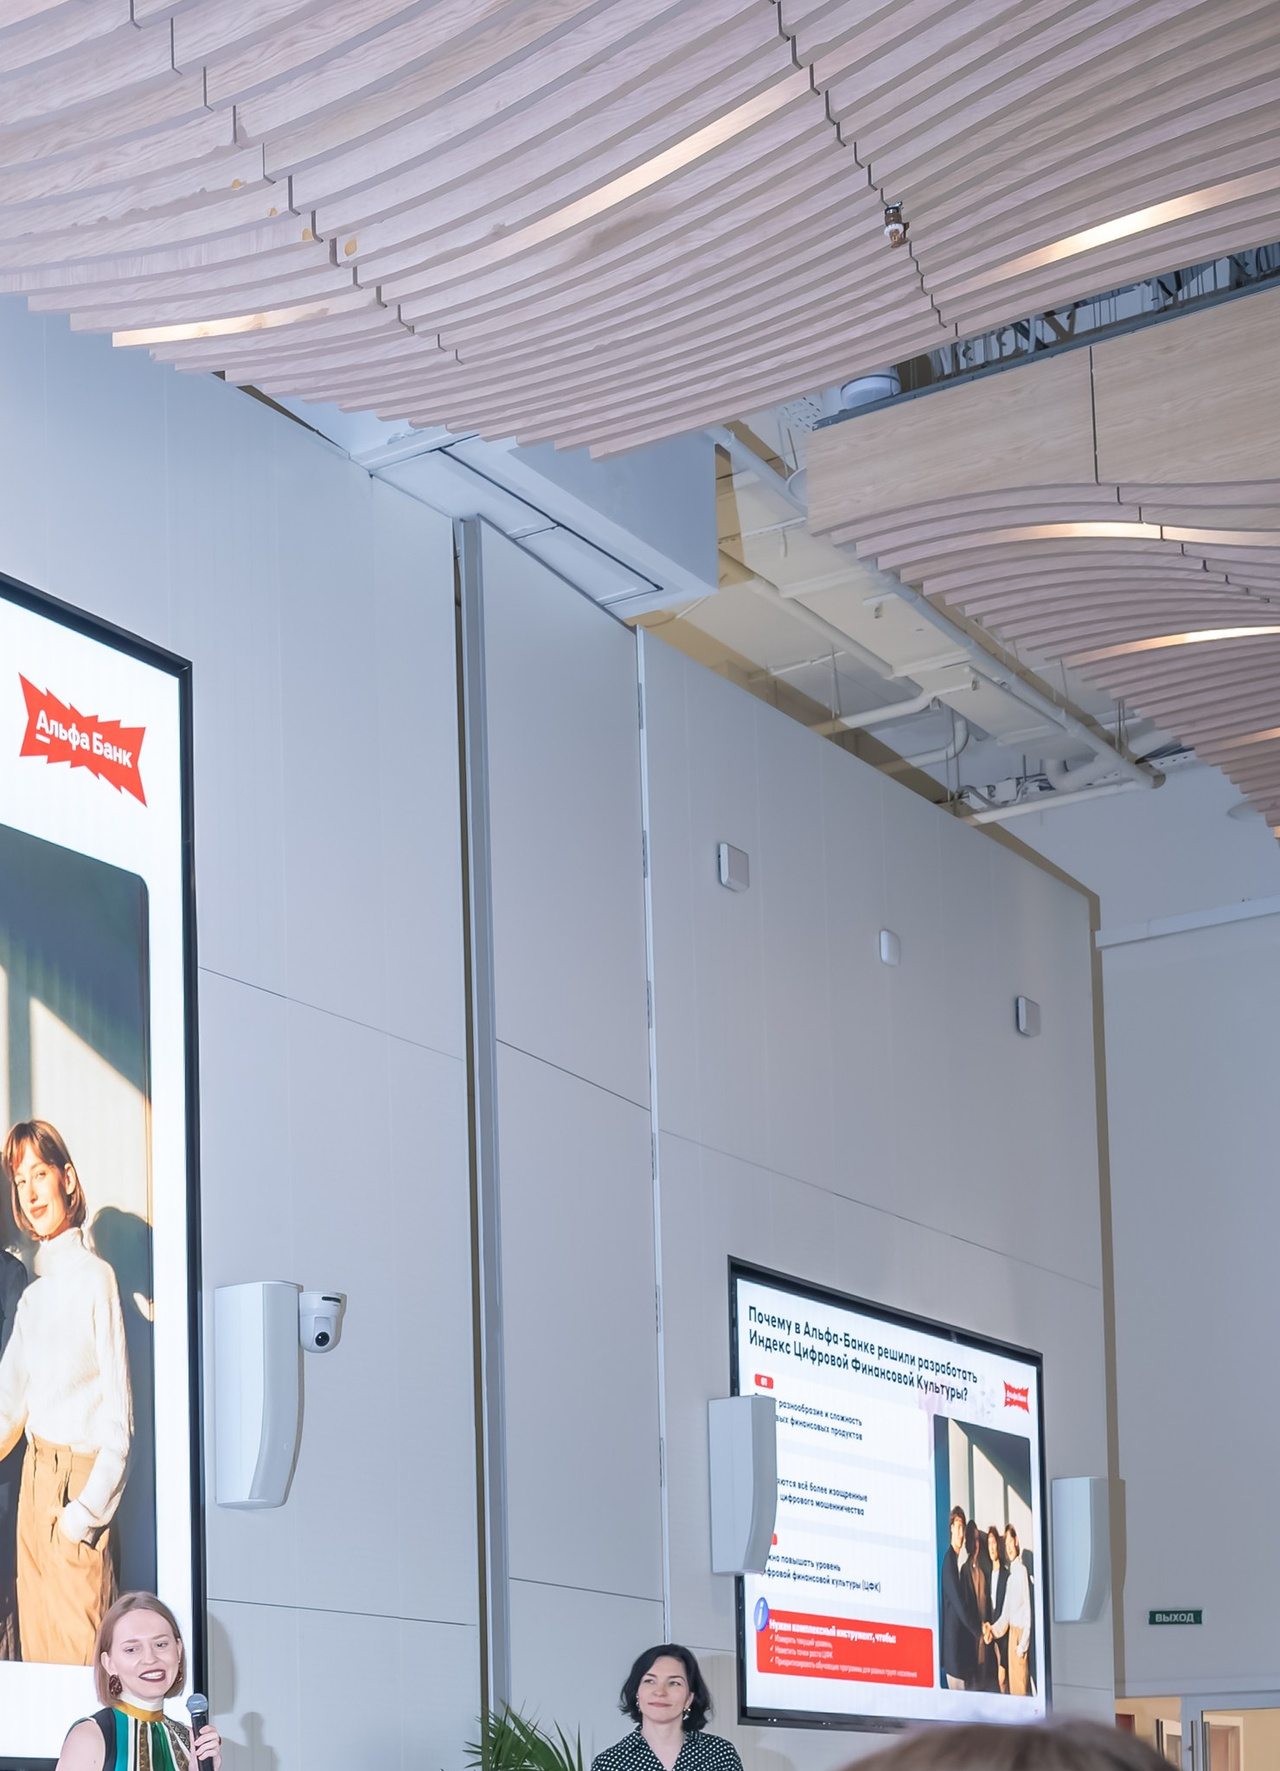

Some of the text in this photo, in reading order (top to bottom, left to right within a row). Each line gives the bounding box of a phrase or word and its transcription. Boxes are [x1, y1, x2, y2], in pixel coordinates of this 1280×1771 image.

[36, 709, 133, 769] Альфа Банк
[749, 1305, 978, 1383] Почему в Альфа-Банке решили разработать
[749, 1329, 968, 1401] Индекс Цифровой Финансовой Культуры?
[1155, 1613, 1195, 1623] ВЫХОД
